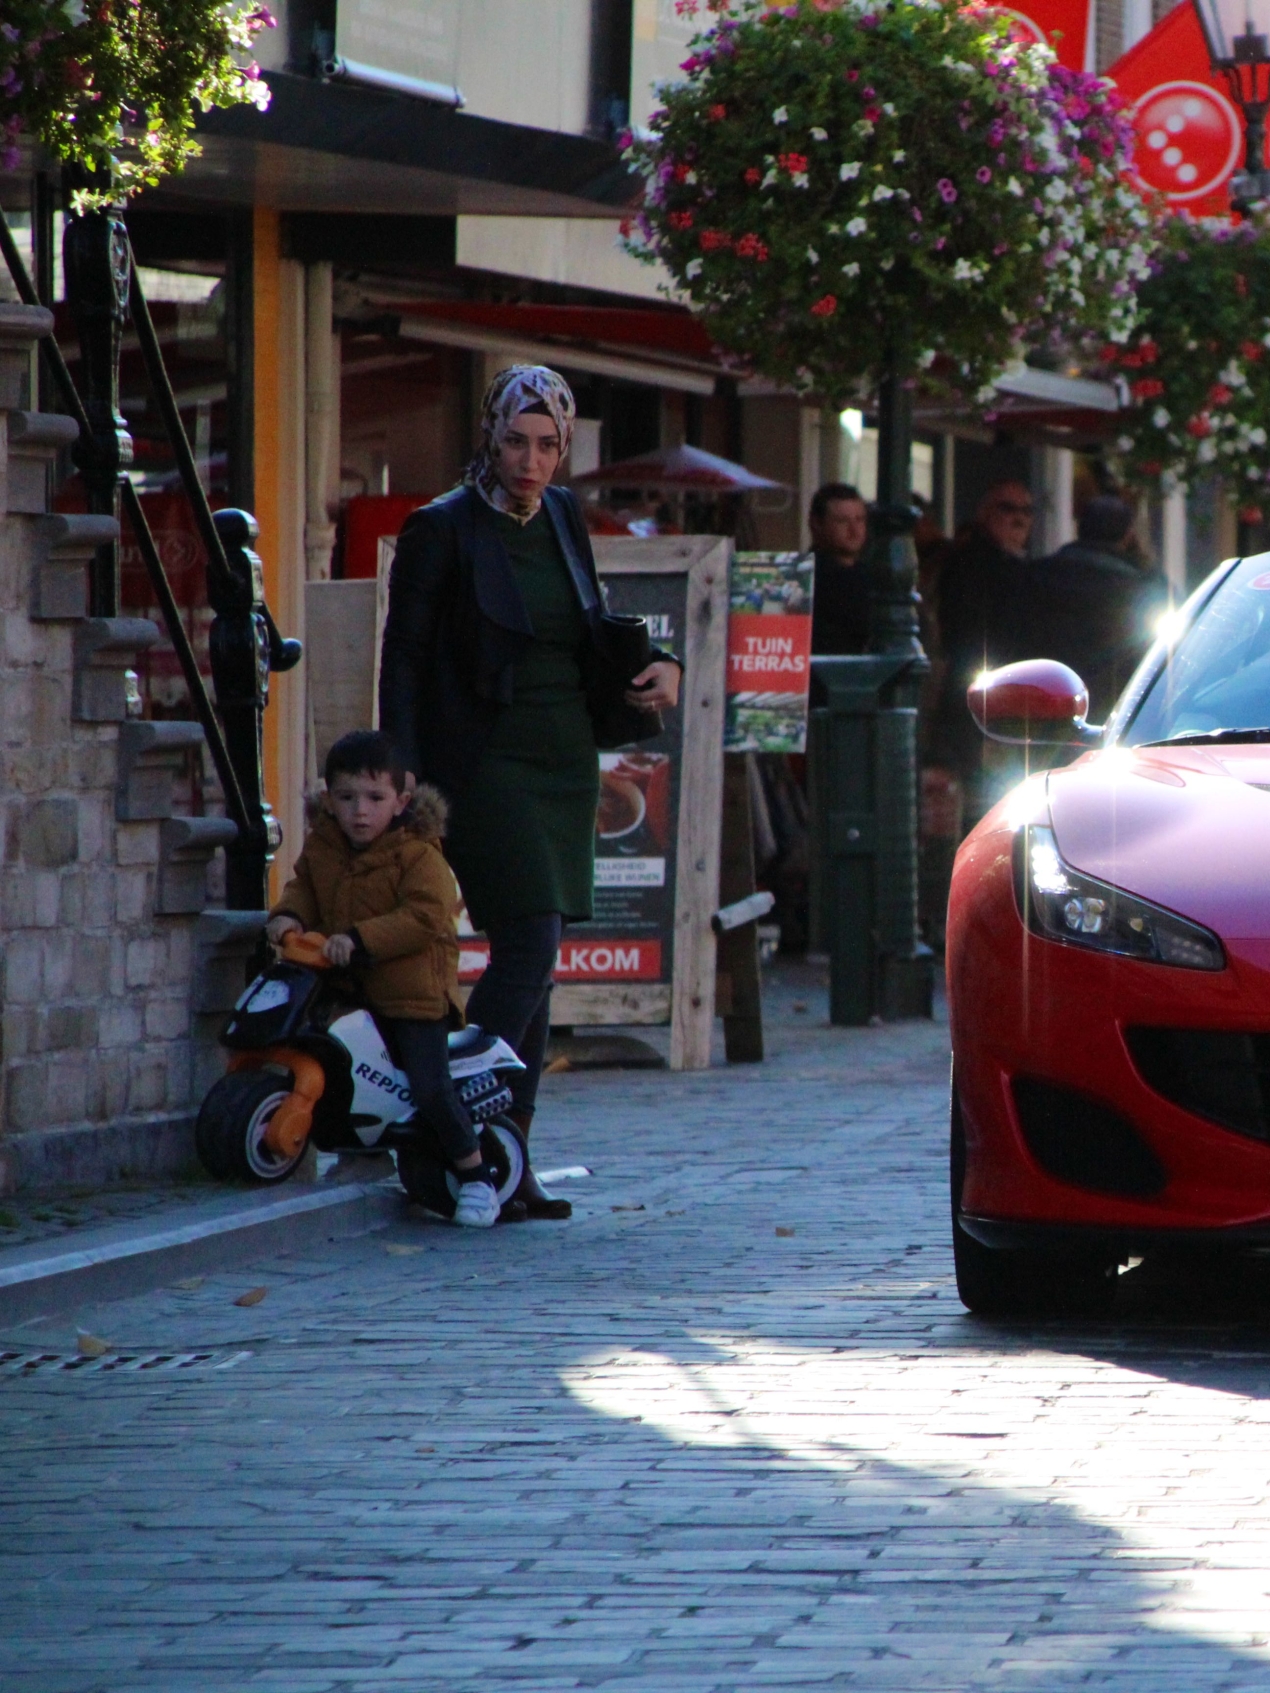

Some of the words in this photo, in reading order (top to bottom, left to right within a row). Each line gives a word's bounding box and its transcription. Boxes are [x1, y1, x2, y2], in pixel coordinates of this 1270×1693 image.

[745, 636, 793, 655] TUIN
[731, 654, 806, 673] TERRAS
[555, 948, 640, 973] LKOM
[355, 1062, 417, 1109] REPSO
